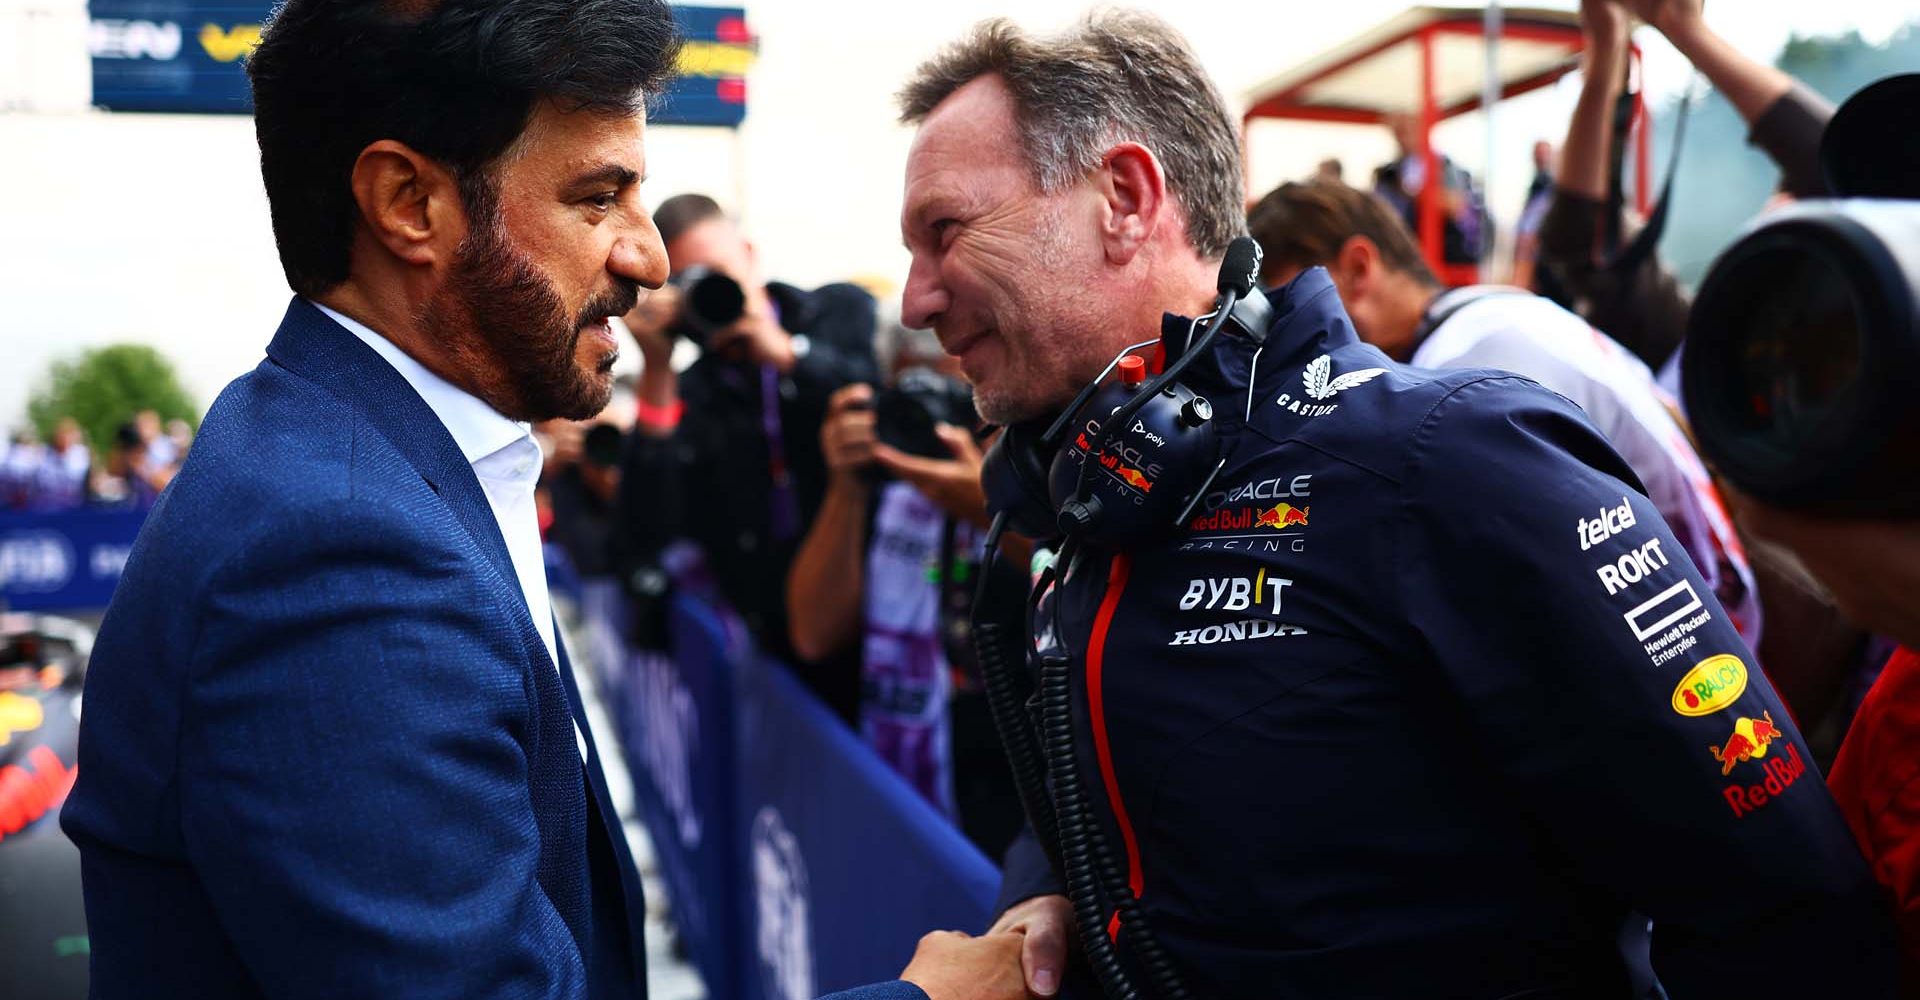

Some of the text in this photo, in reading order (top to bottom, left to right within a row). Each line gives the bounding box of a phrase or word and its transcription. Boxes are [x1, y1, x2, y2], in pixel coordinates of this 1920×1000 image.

[1075, 432, 1118, 470] Re ull
[1145, 432, 1165, 447] poly
[1205, 474, 1312, 510] ORACLE
[1221, 507, 1252, 530] Bull
[1577, 496, 1636, 550] telcel
[1179, 539, 1305, 552] RACING
[1597, 538, 1669, 595] ROKT
[1179, 568, 1294, 615] BYBIT
[1168, 619, 1308, 645] HONDA
[1644, 609, 1711, 655] Hewlett Packard
[1651, 636, 1697, 667] Enterprise
[1694, 664, 1740, 701] RAUCH
